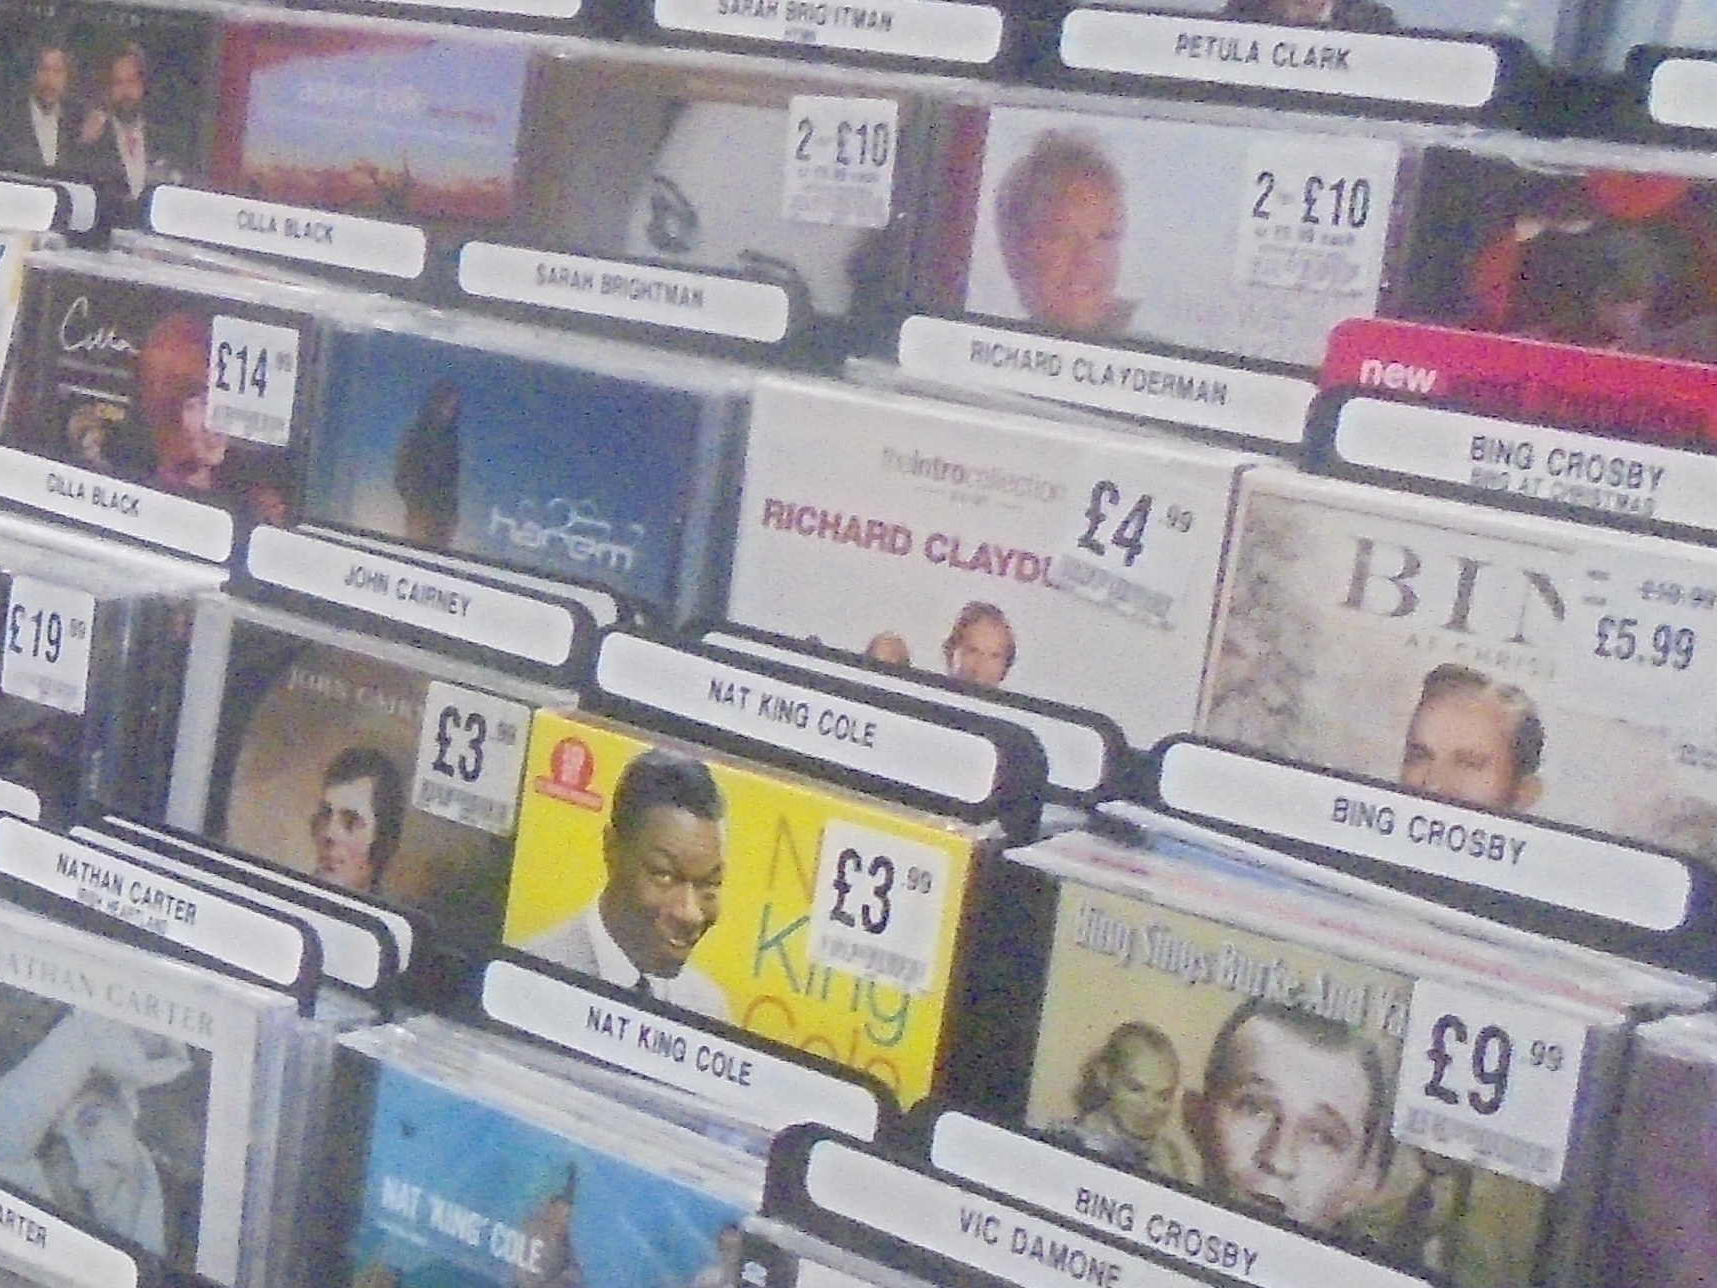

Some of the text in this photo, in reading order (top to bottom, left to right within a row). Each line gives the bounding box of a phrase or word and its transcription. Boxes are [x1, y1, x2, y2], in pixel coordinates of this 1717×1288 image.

[1175, 31, 1350, 72] PETULA CLARK
[237, 208, 334, 246] CILLA BLACK
[536, 263, 704, 308] SARAH BRIGHTMAN
[970, 338, 1229, 405] RICHARD CLAYDERMAN
[1359, 358, 1438, 393] new
[1470, 434, 1666, 491] BING CROSBY
[47, 473, 141, 518] CILLA BLACK
[344, 564, 471, 617] JOHN CAIRNEY
[1595, 614, 1696, 672] £5.99
[708, 676, 877, 749] NAT KING COLE
[1331, 797, 1527, 866] BING CROSBY
[56, 853, 198, 925] NATHAN CARTER
[587, 1006, 753, 1087] NAT KING COLE
[1423, 1014, 1564, 1116] £9.99
[959, 1208, 1000, 1246] VIC
[1076, 1186, 1259, 1277] BING CROSBY
